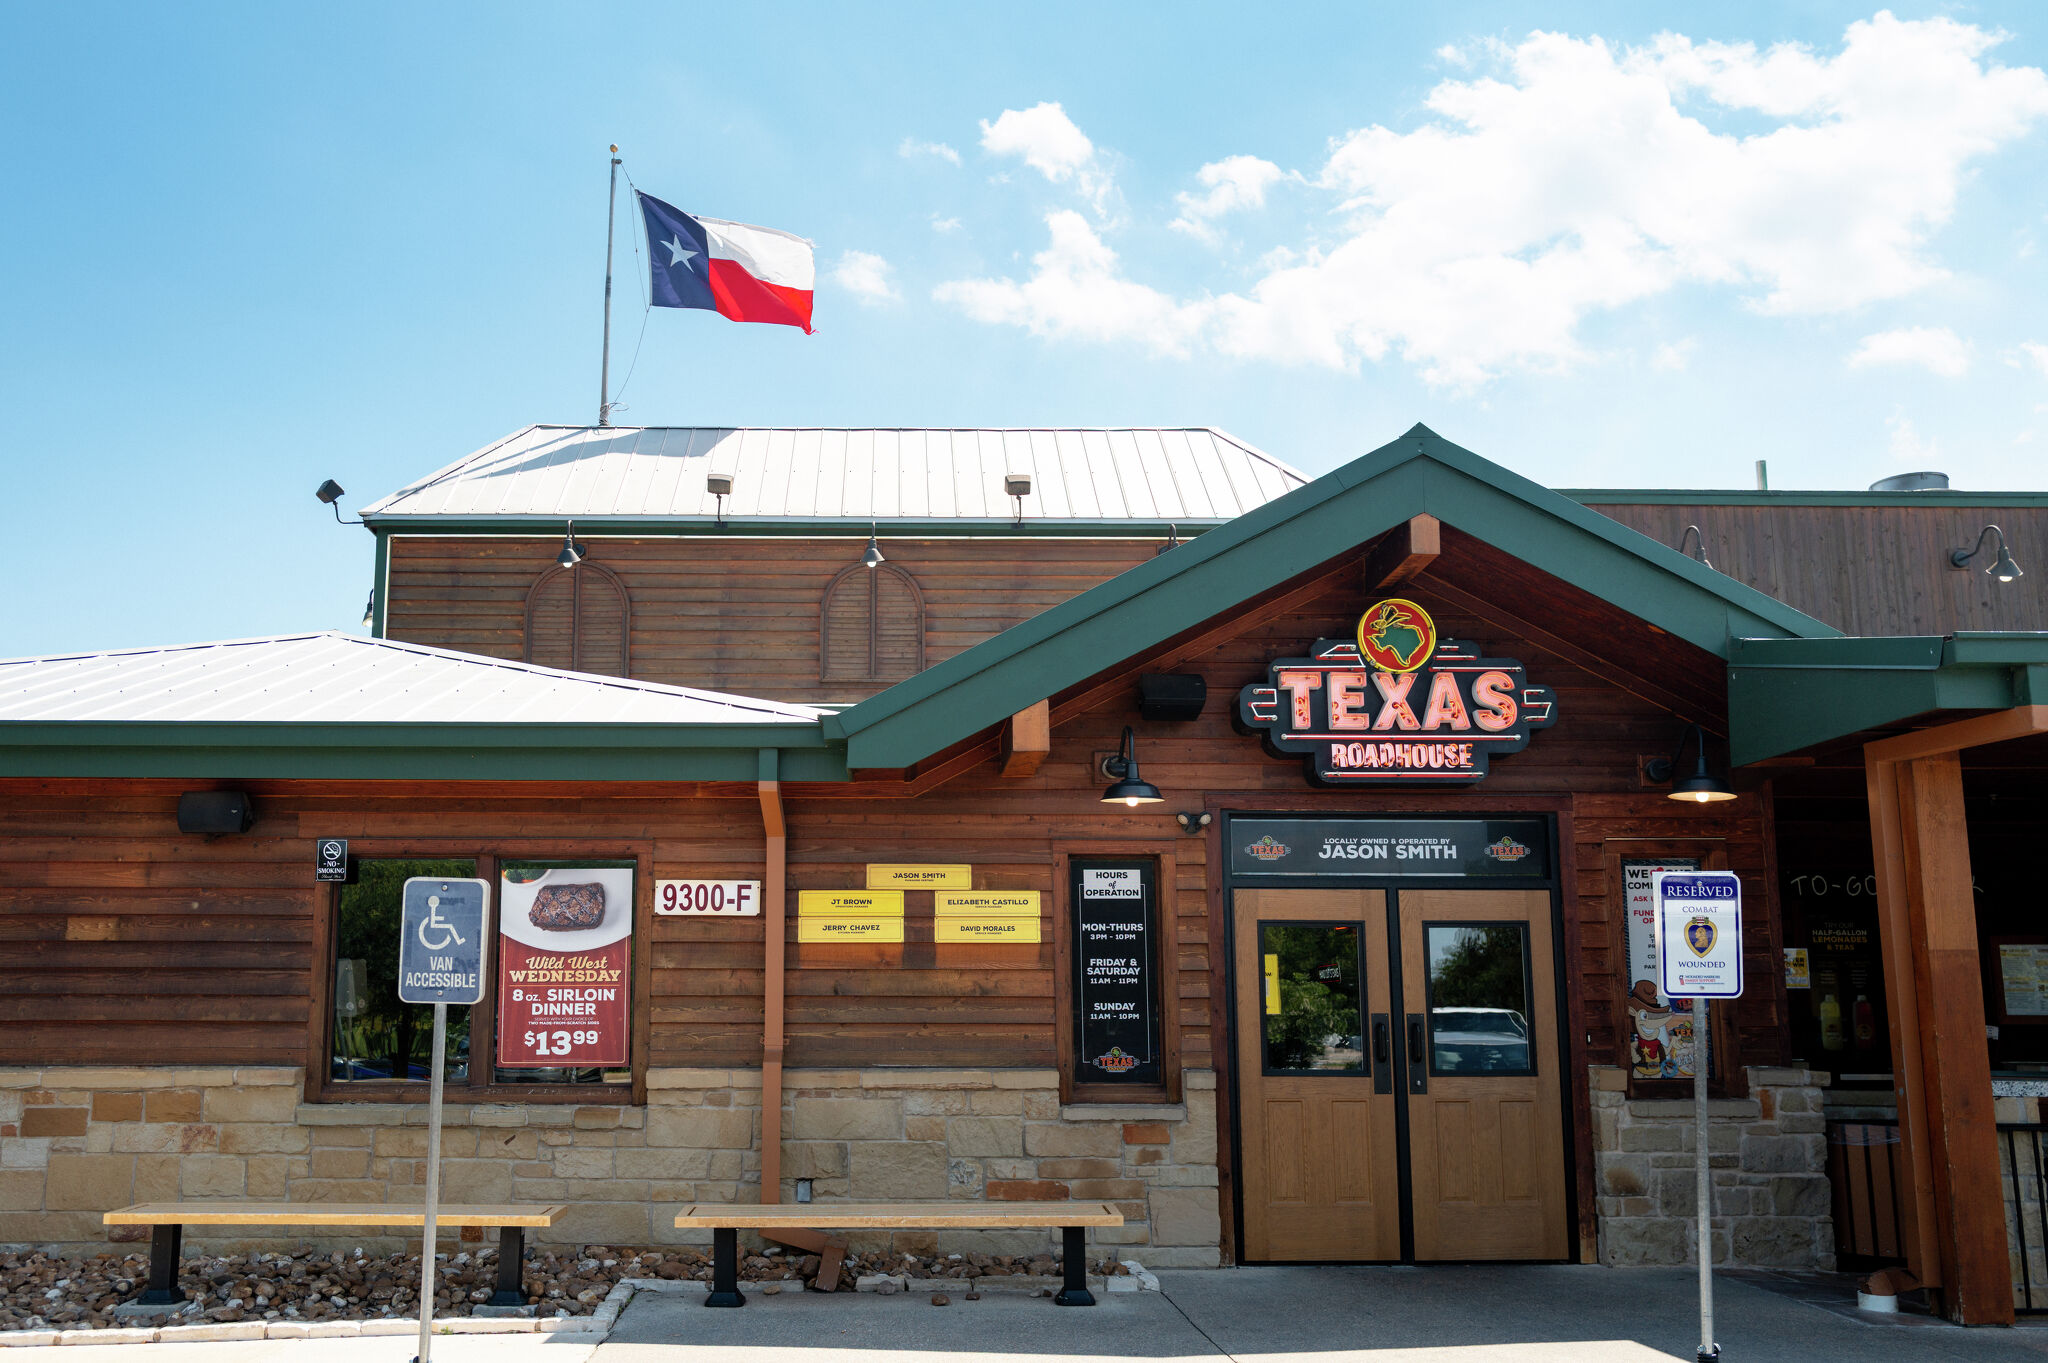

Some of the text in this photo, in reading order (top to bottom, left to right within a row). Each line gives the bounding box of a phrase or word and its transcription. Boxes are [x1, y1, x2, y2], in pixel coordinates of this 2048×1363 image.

[1277, 670, 1518, 732] TEXAS
[1331, 743, 1475, 769] ROADHOUSE
[1252, 846, 1285, 855] TEXAS
[1318, 845, 1457, 860] JASON SMITH
[1491, 847, 1524, 856] TEXAS
[1627, 869, 1648, 879] WE
[1108, 880, 1117, 889] of
[1790, 875, 1877, 896] TO-GO
[1085, 889, 1139, 897] OPERATION
[1667, 886, 1733, 897] RESERVED
[663, 884, 752, 912] 9300-F
[1082, 923, 1144, 932] MON-THURS
[430, 956, 453, 971] VAN
[526, 956, 608, 969] Wild West
[1090, 958, 1137, 967] FRIDAY &
[509, 970, 622, 983] WEDNESDAY
[1086, 967, 1141, 975] SATURDAY
[405, 972, 476, 988] ACCESSIBLE
[512, 989, 524, 1001] 8
[547, 988, 616, 1001] SIRLOIN
[531, 1003, 597, 1016] DINNER
[1093, 1002, 1135, 1011] SUNDAY
[1100, 1057, 1133, 1066] TEXAS
